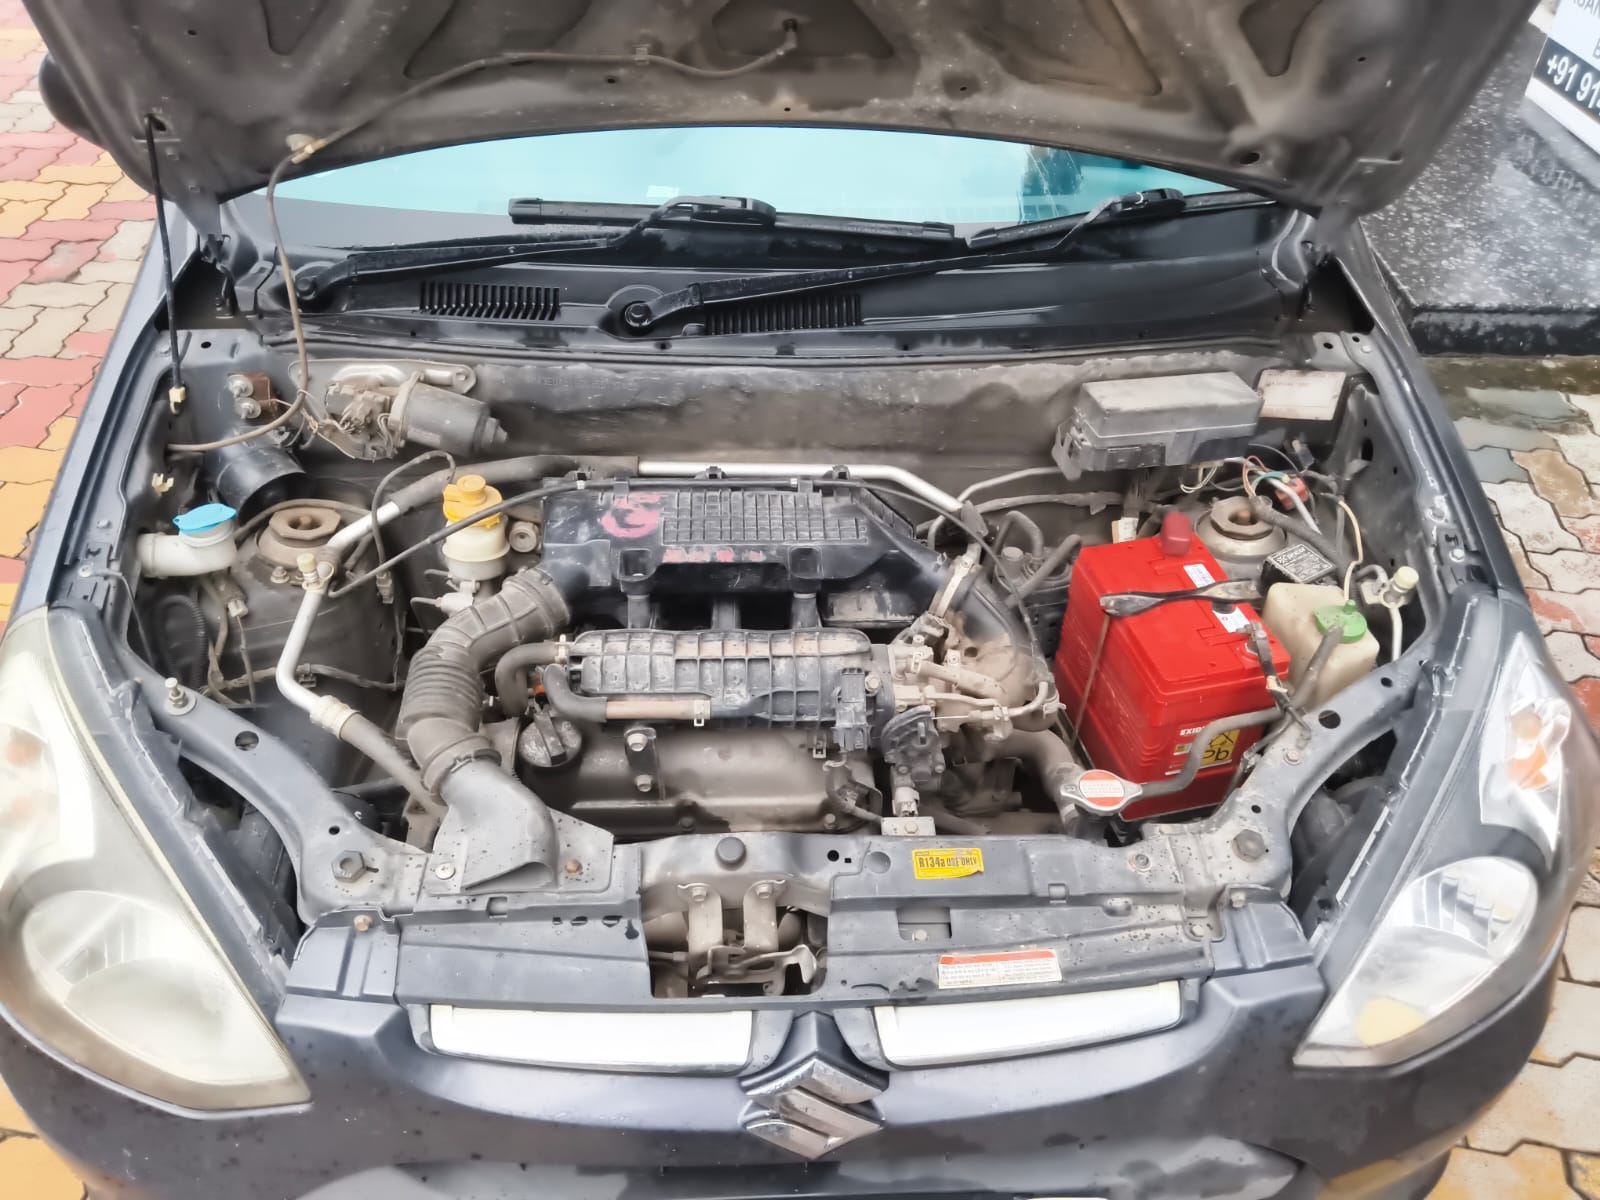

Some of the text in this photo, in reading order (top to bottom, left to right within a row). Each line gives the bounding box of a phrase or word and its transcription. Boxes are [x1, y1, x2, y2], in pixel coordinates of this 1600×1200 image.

[1547, 54, 1579, 92] +91
[1179, 726, 1206, 737] EXID
[918, 856, 946, 868] R134a
[961, 856, 977, 866] ONLY
